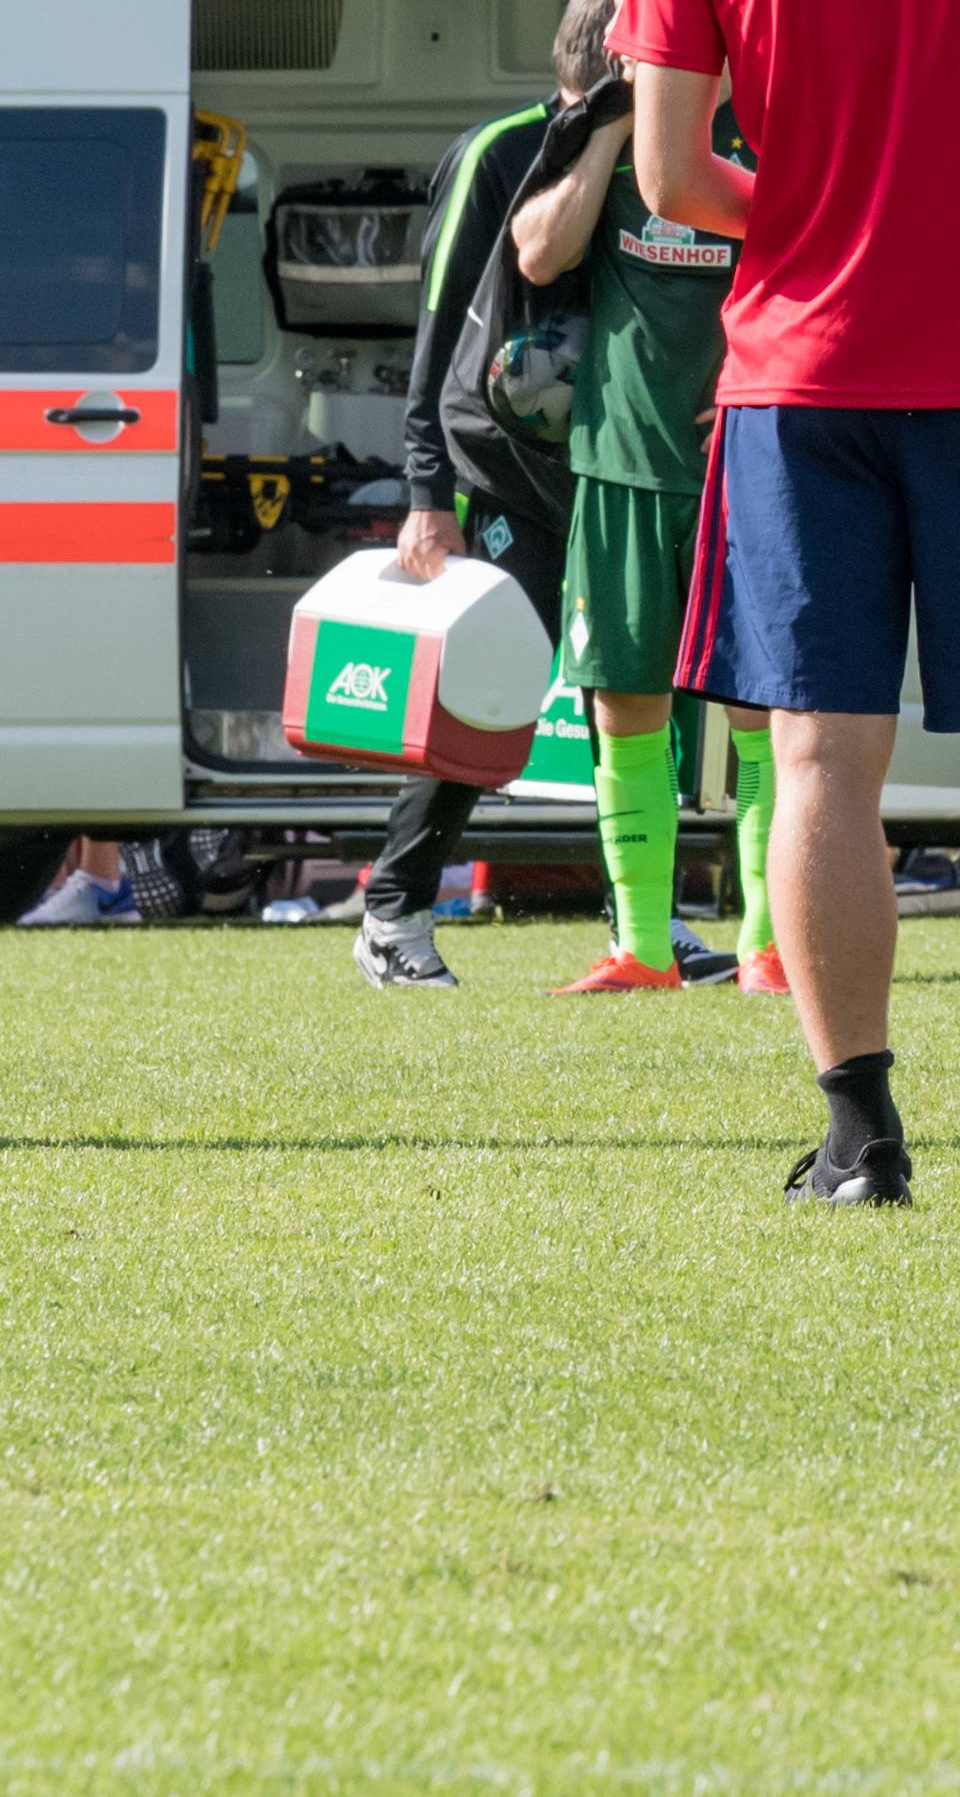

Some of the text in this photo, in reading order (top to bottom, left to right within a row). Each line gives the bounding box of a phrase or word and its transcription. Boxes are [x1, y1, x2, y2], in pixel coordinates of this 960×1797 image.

[622, 233, 728, 263] WIESENHOF
[328, 662, 392, 702] AOK
[556, 719, 590, 740] Gesu
